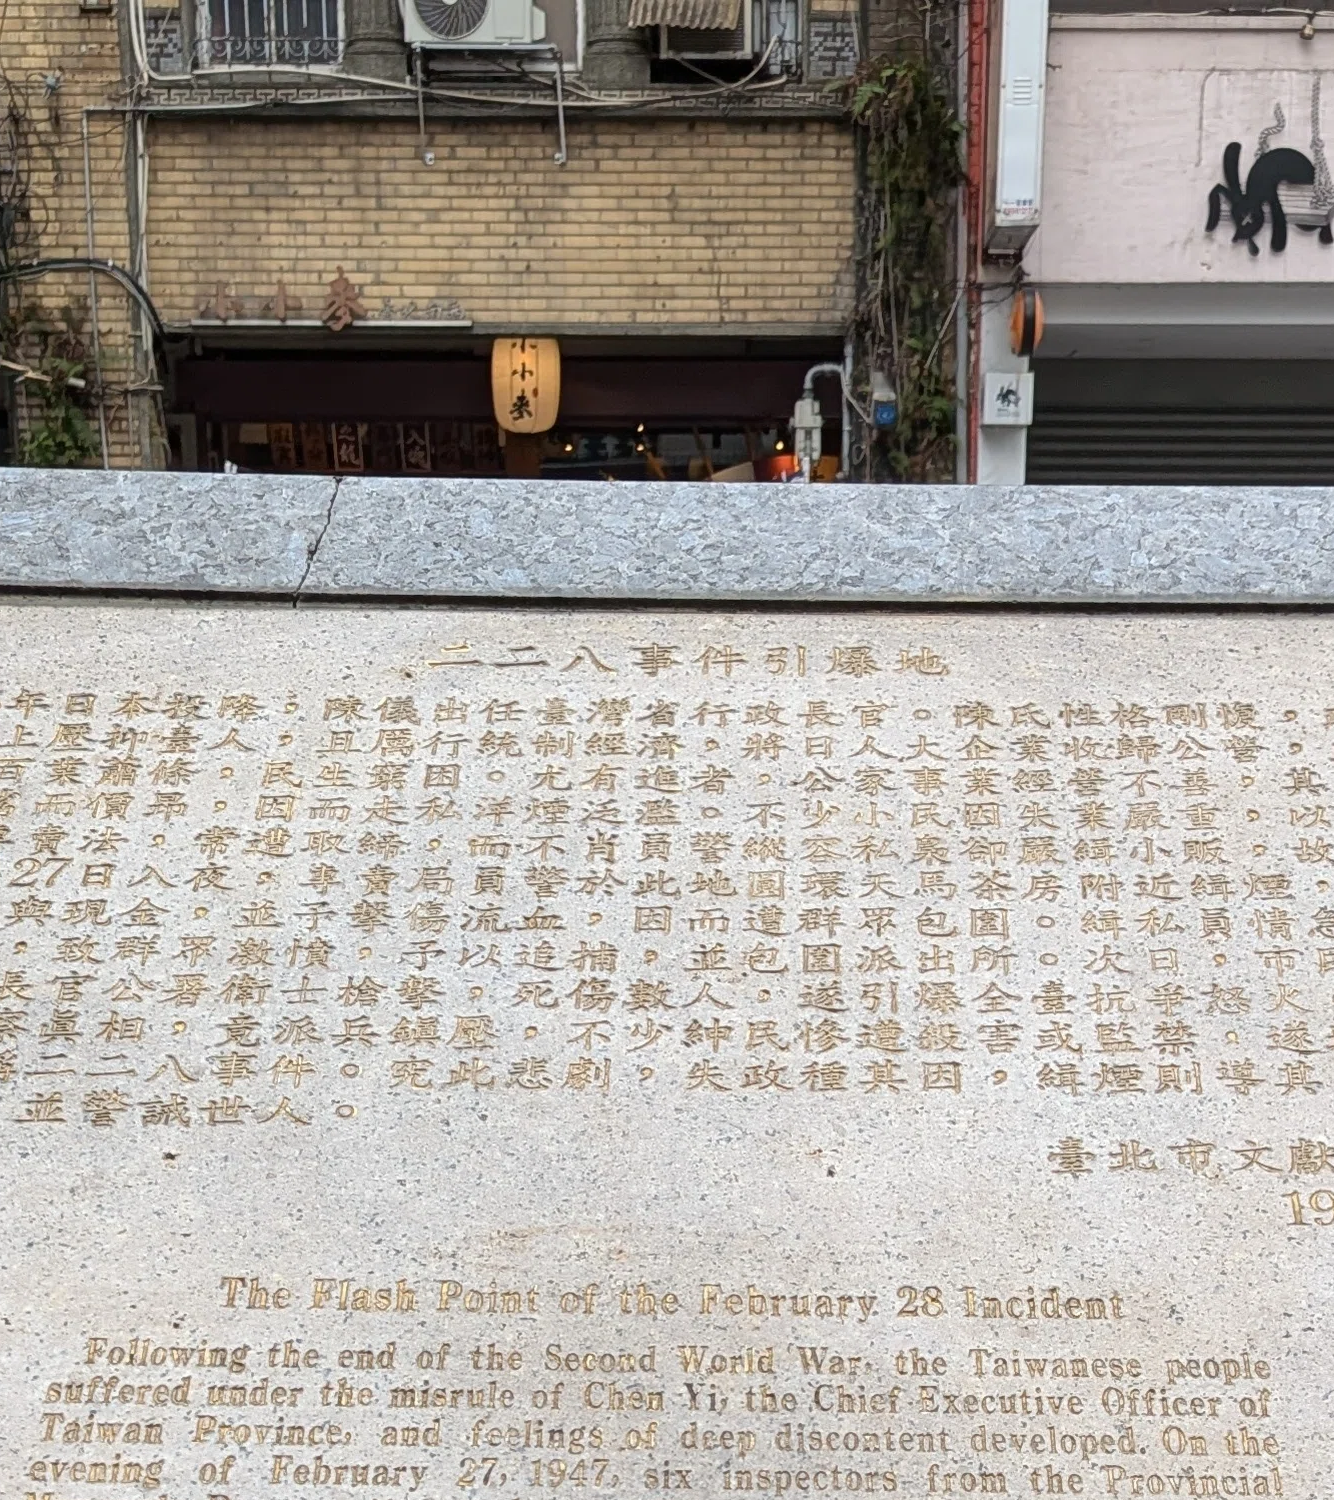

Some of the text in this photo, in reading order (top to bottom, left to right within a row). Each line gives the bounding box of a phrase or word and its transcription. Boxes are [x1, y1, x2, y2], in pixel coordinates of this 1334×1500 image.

[422, 641, 950, 679] 二二八事件引爆地
[216, 1276, 1125, 1325] The Flash Point of the February 28 Incident
[79, 1338, 1273, 1387] Following the end of the Second World War, the Taiwanese people
[43, 1376, 1276, 1418] suffered under the misrule of Chen Yi, the Chief Executive Officer of
[38, 1415, 1282, 1461] Taiwan Province, and feelings of deep discontent developed. On the
